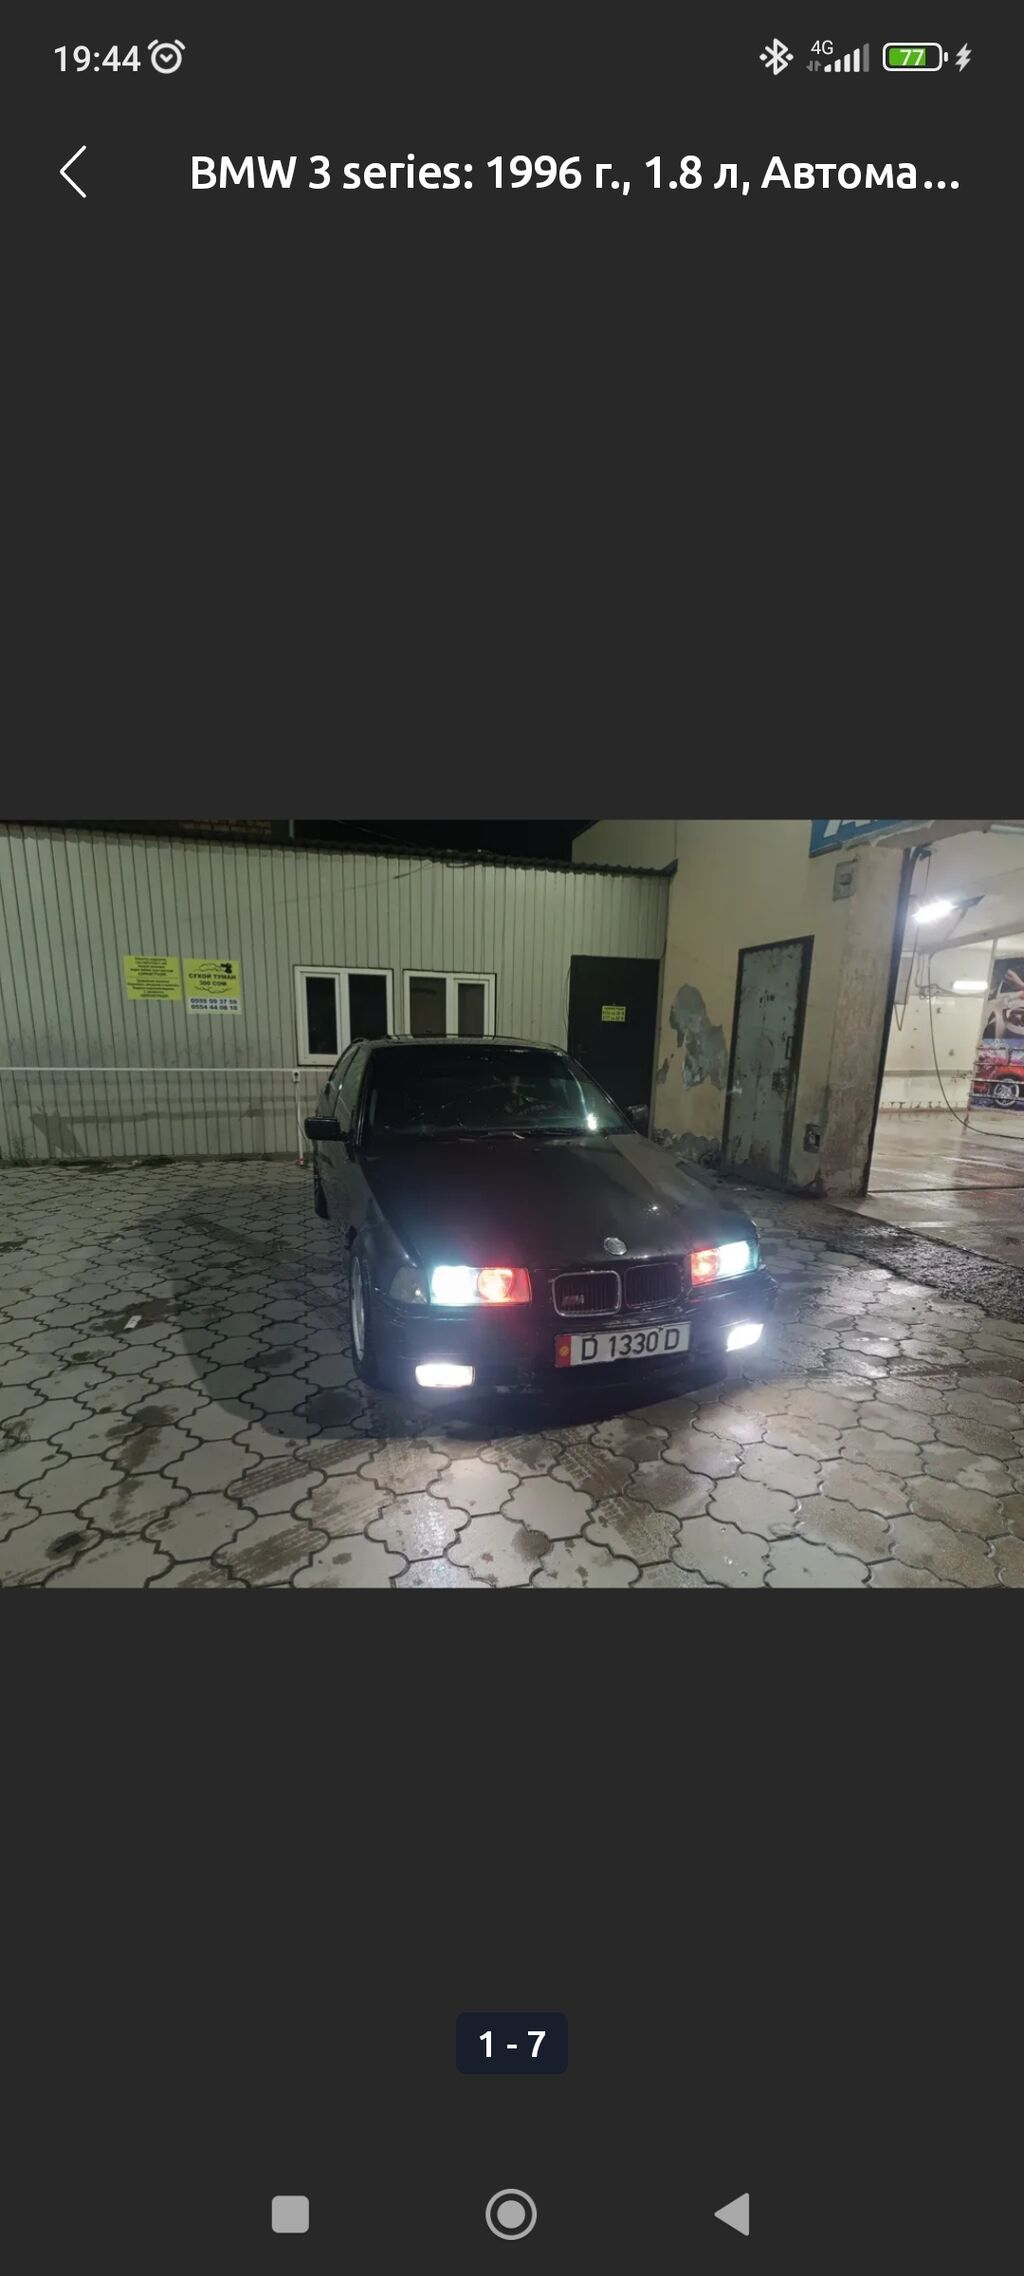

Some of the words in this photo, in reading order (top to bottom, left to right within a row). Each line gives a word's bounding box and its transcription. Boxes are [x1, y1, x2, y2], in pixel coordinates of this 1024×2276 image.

[581, 1337, 599, 1361] D
[608, 1331, 659, 1358] 1330
[664, 1328, 681, 1351] D
